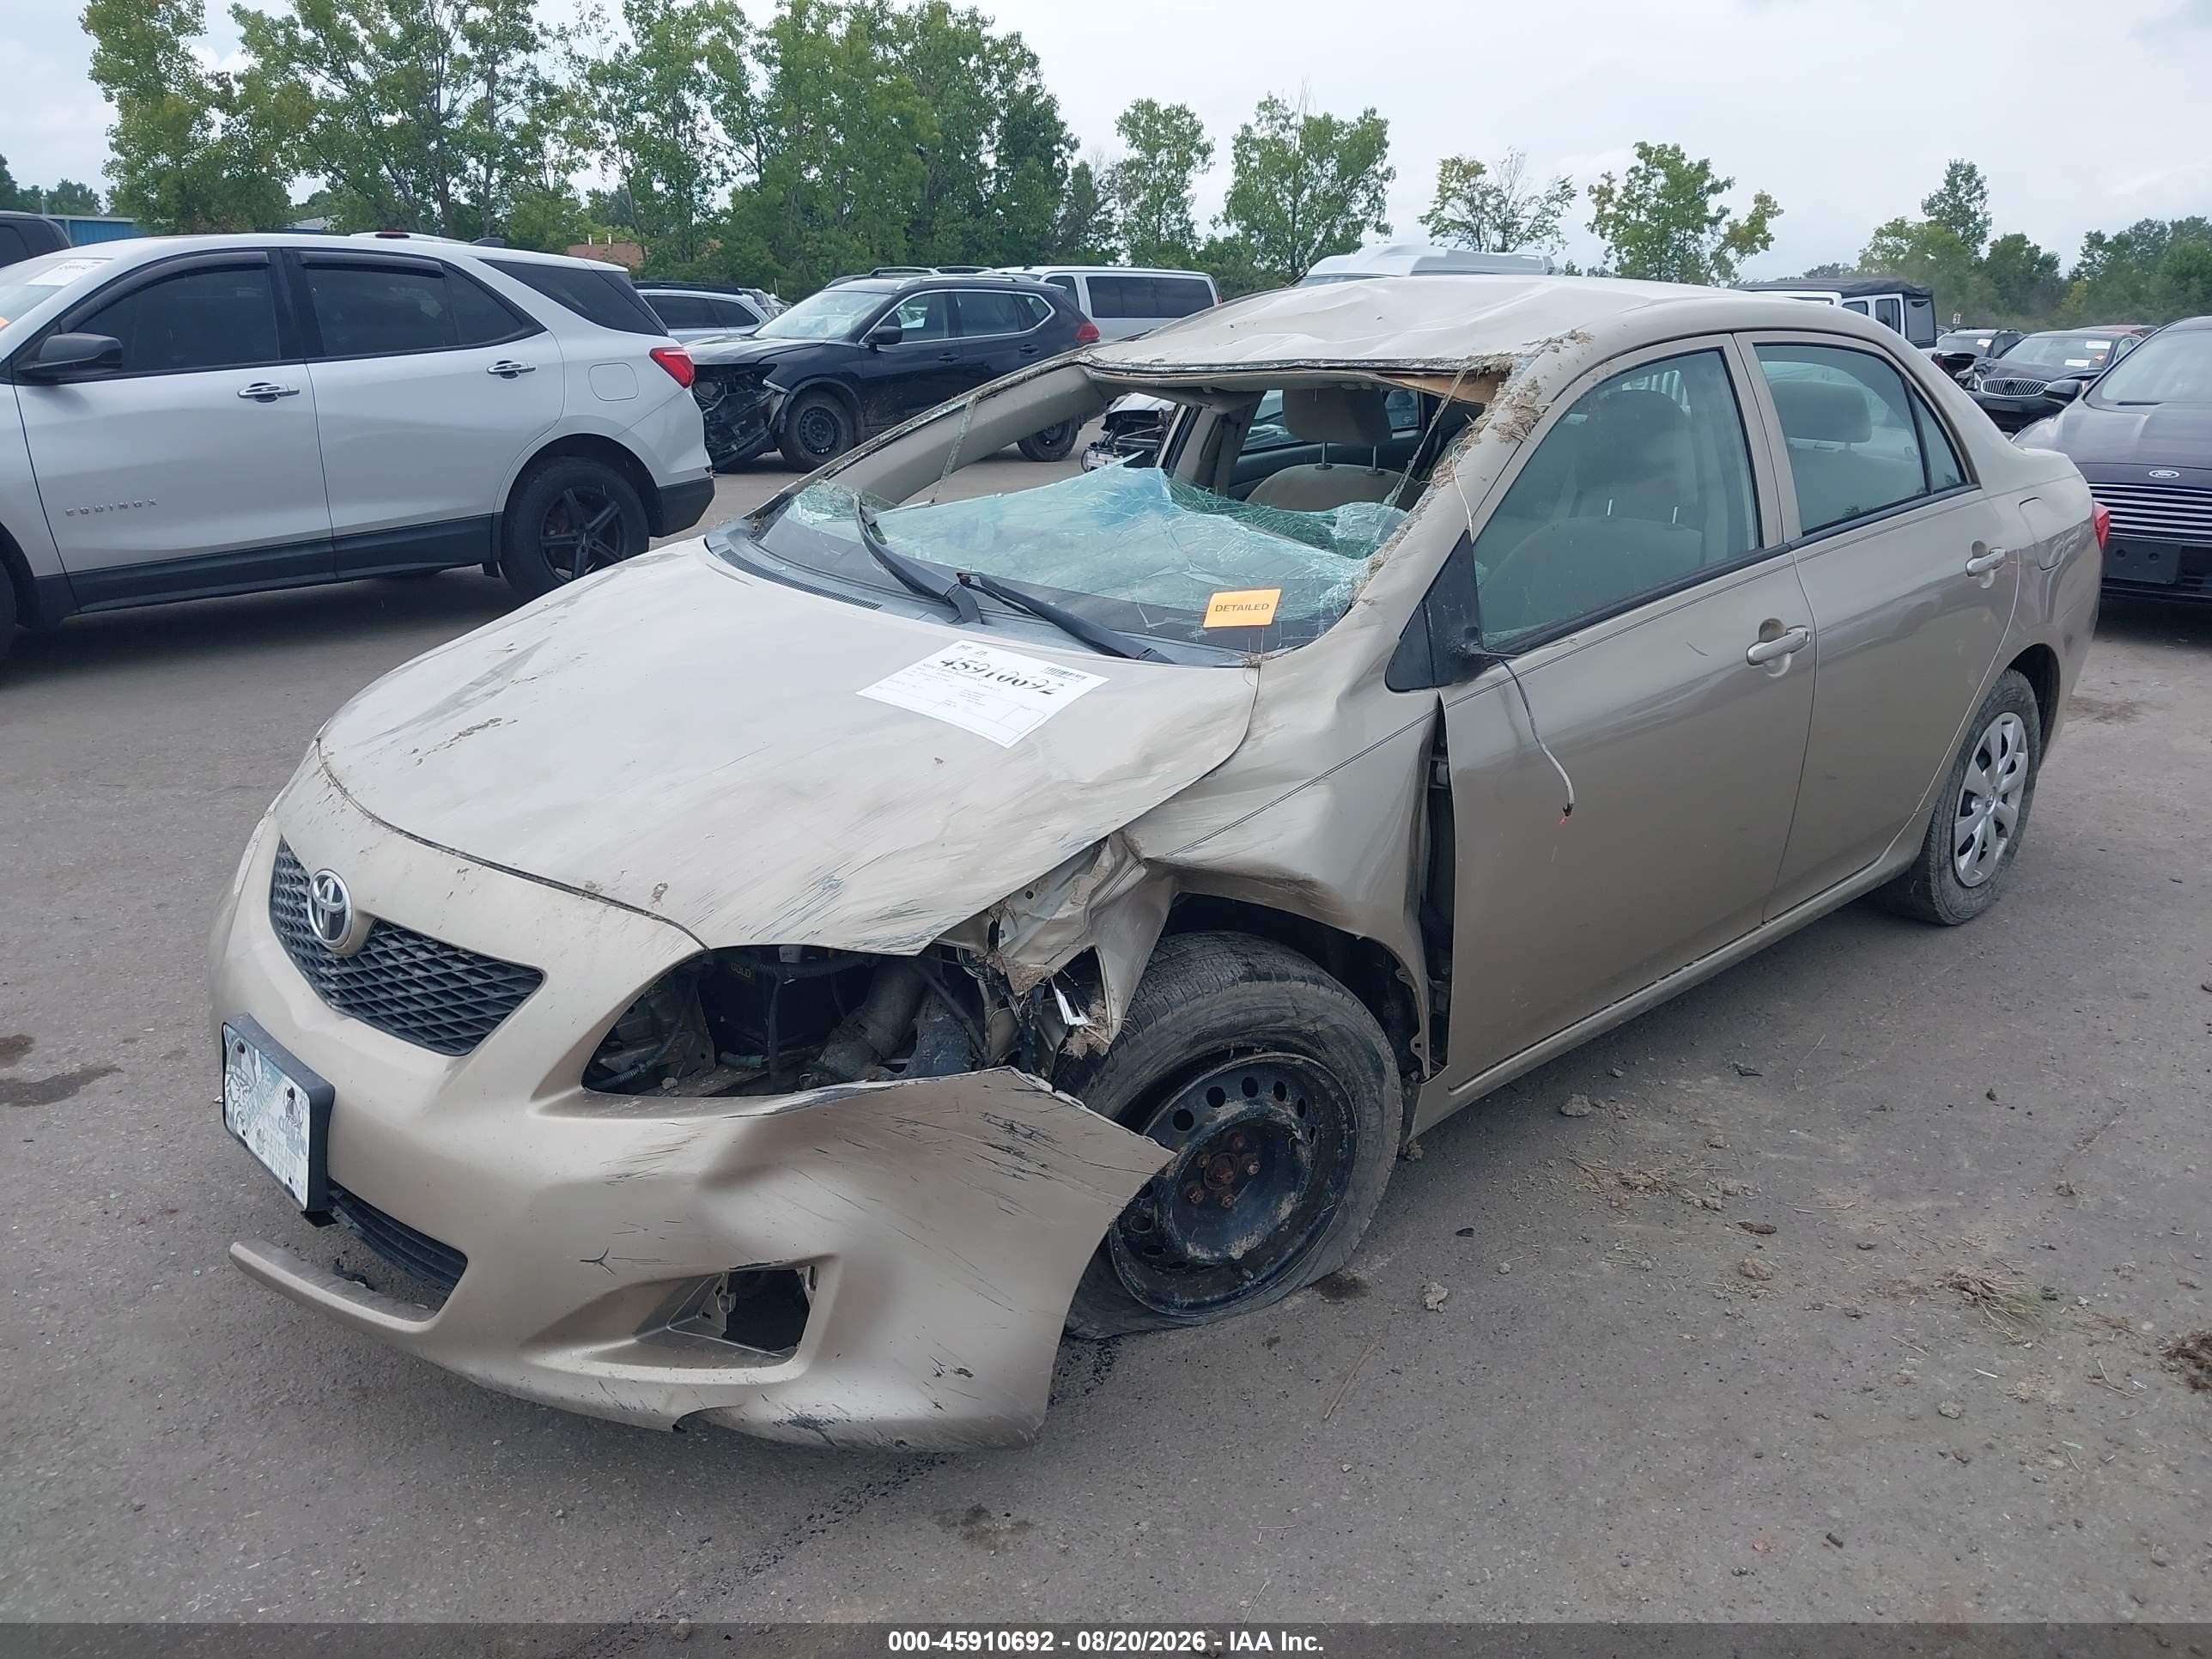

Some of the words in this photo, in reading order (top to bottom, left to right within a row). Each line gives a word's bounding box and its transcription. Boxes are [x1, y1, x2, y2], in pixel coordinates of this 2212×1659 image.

[65, 498, 158, 516] EQUINOX
[1214, 603, 1270, 612] DETAILED
[939, 657, 1066, 696] 45910692
